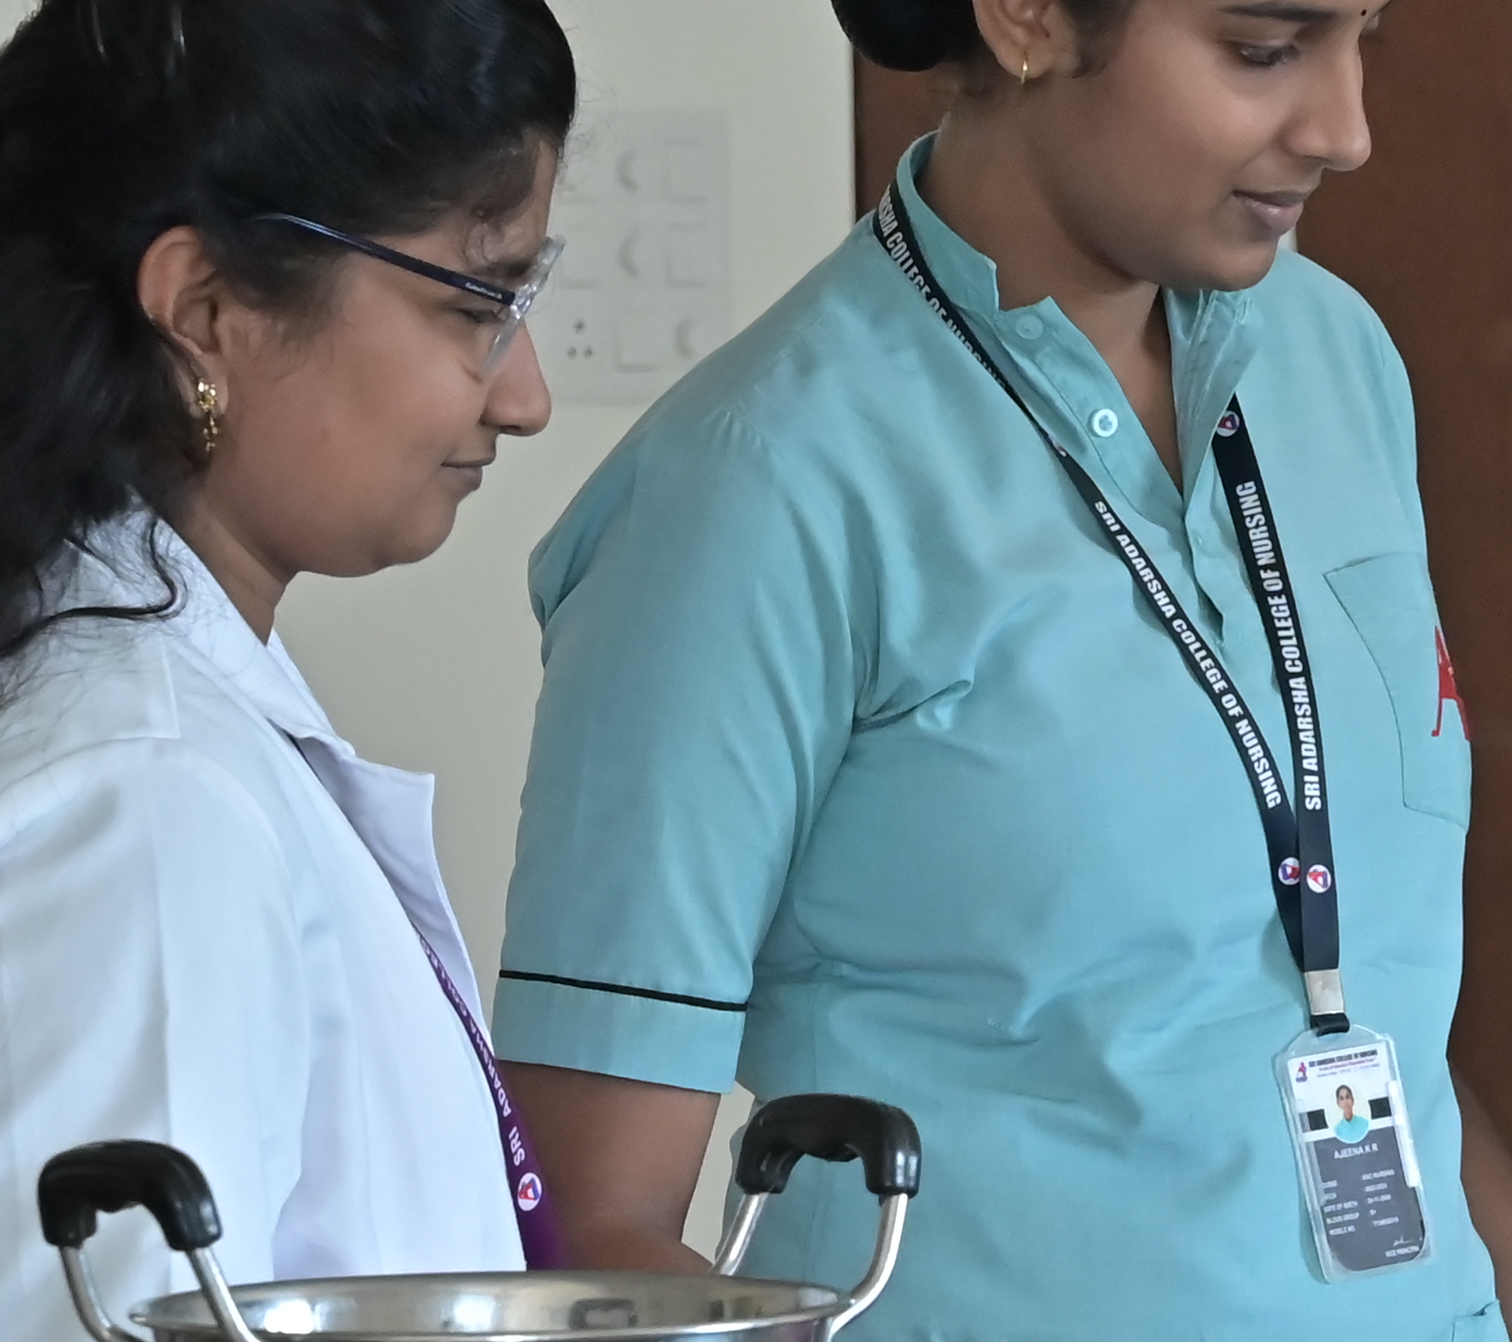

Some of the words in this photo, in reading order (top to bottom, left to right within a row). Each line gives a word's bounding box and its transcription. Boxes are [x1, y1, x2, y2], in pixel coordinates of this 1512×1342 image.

[1236, 480, 1276, 566] NURSING
[1260, 569, 1284, 593] OF
[1095, 500, 1121, 533] SRI
[1116, 533, 1177, 619] ADARSHA
[1172, 617, 1230, 694] COLLEGE
[1221, 693, 1245, 717] OF
[1235, 718, 1283, 810] NURSING
[1267, 594, 1304, 675] COLLEGE
[1289, 676, 1322, 772] ADARSHA
[1304, 776, 1322, 811] SRI
[508, 1125, 527, 1167] SRI
